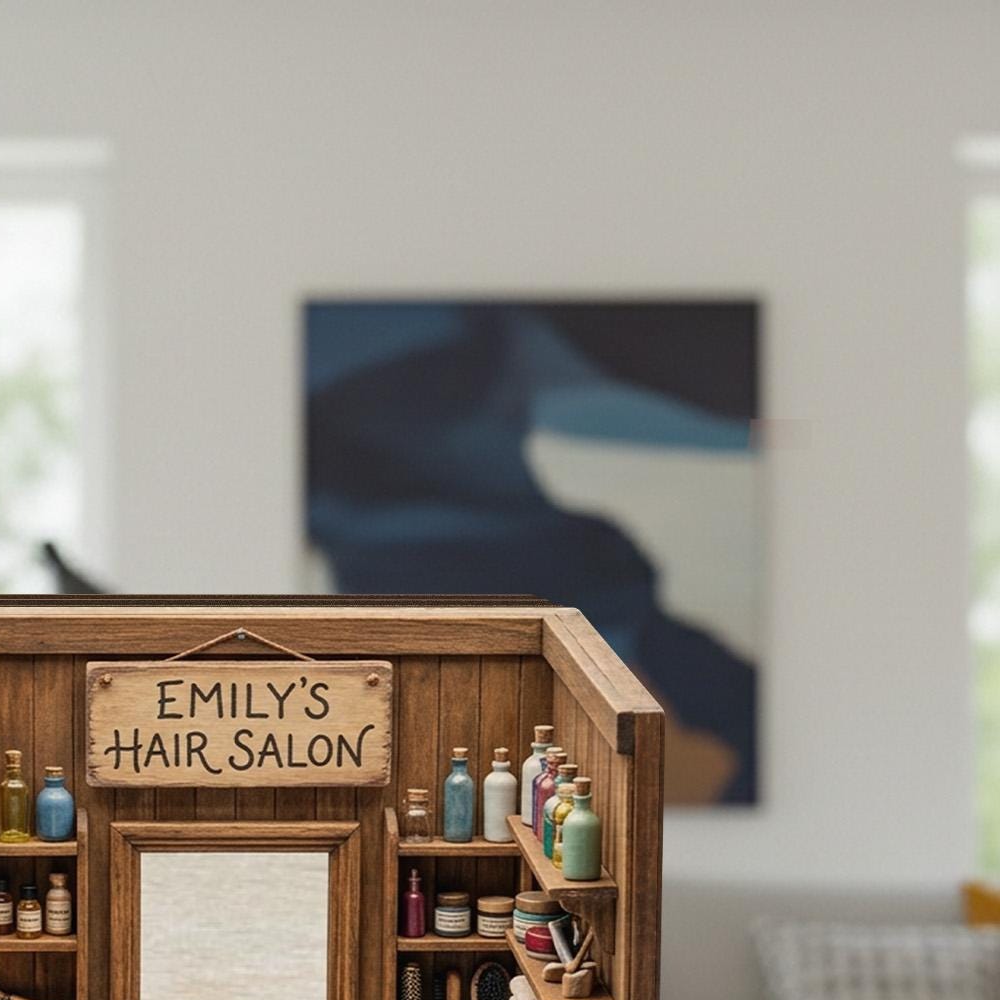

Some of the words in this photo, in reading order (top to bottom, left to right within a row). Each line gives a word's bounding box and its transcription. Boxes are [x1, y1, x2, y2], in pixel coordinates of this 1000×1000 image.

[157, 676, 330, 720] EMILY'S
[104, 728, 223, 774] HAIR
[228, 724, 375, 771] SALON
